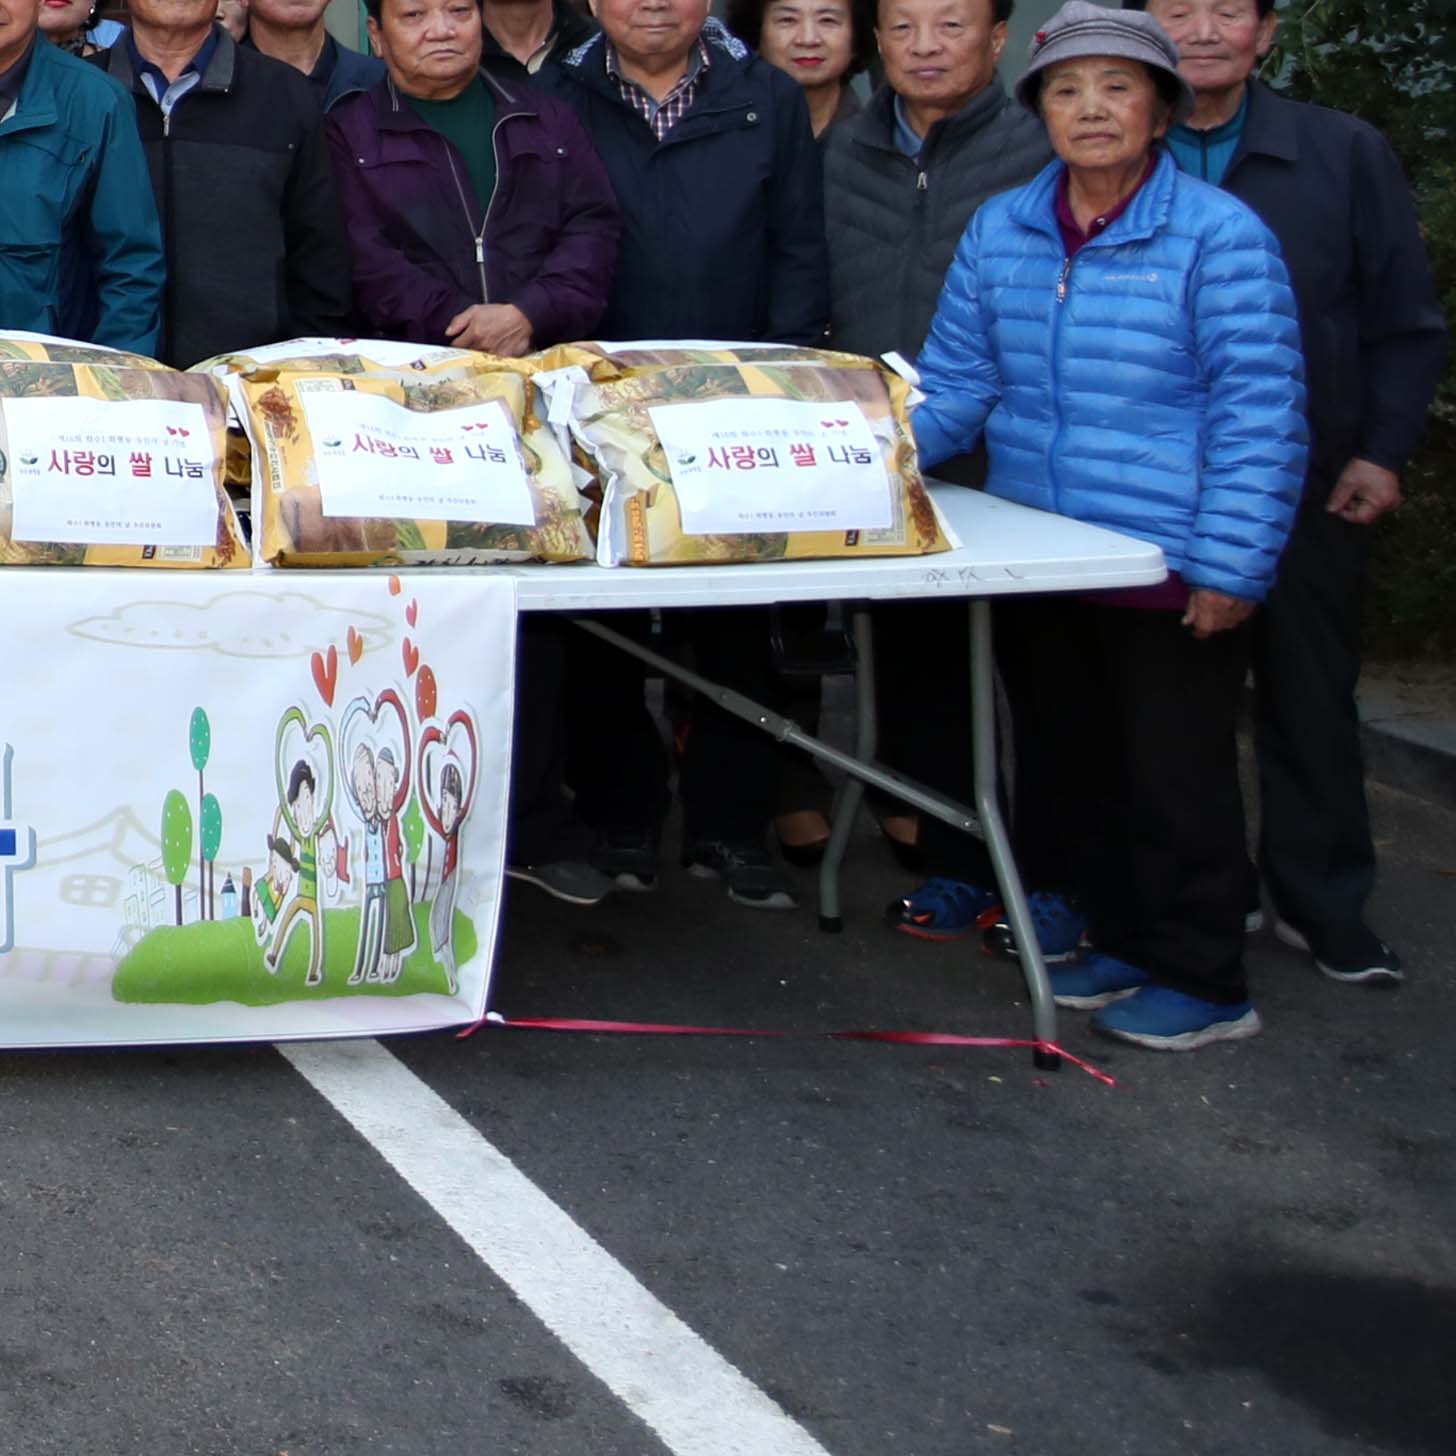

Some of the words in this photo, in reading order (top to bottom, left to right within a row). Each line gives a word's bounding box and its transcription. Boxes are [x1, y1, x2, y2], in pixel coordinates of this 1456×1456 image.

[47, 449, 117, 478] 사랑의
[129, 451, 152, 477] 쌀
[165, 455, 205, 479] 나눔
[352, 433, 421, 461] 사랑의
[429, 446, 455, 465] 쌀
[464, 444, 508, 464] 나눔
[708, 442, 780, 471] 사랑의
[789, 442, 818, 468] 쌀
[828, 444, 873, 465] 나눔
